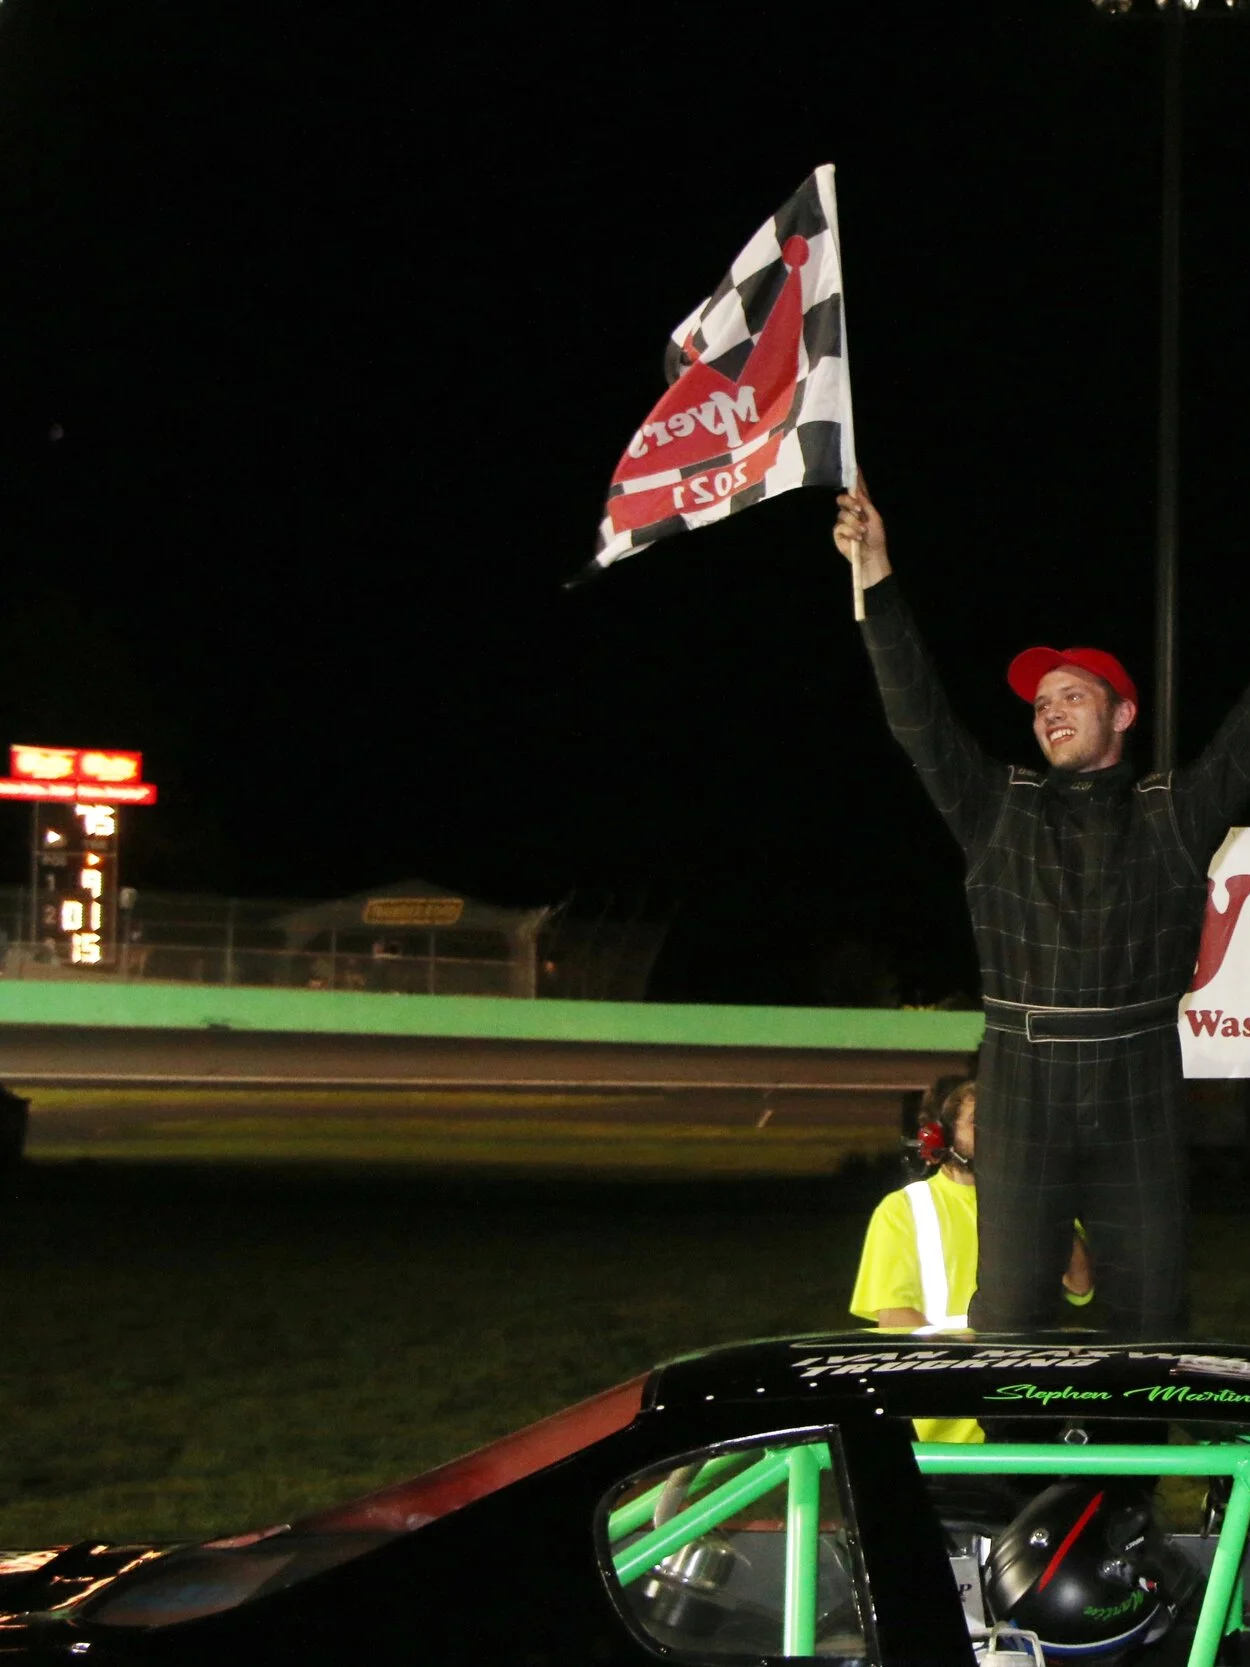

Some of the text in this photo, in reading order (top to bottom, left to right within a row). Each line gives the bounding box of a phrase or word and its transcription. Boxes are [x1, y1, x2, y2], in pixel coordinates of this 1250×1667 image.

[81, 868, 102, 899] 9
[71, 932, 101, 963] 15
[800, 1358, 1101, 1377] TRUCKING
[983, 1384, 1113, 1406] Stephen
